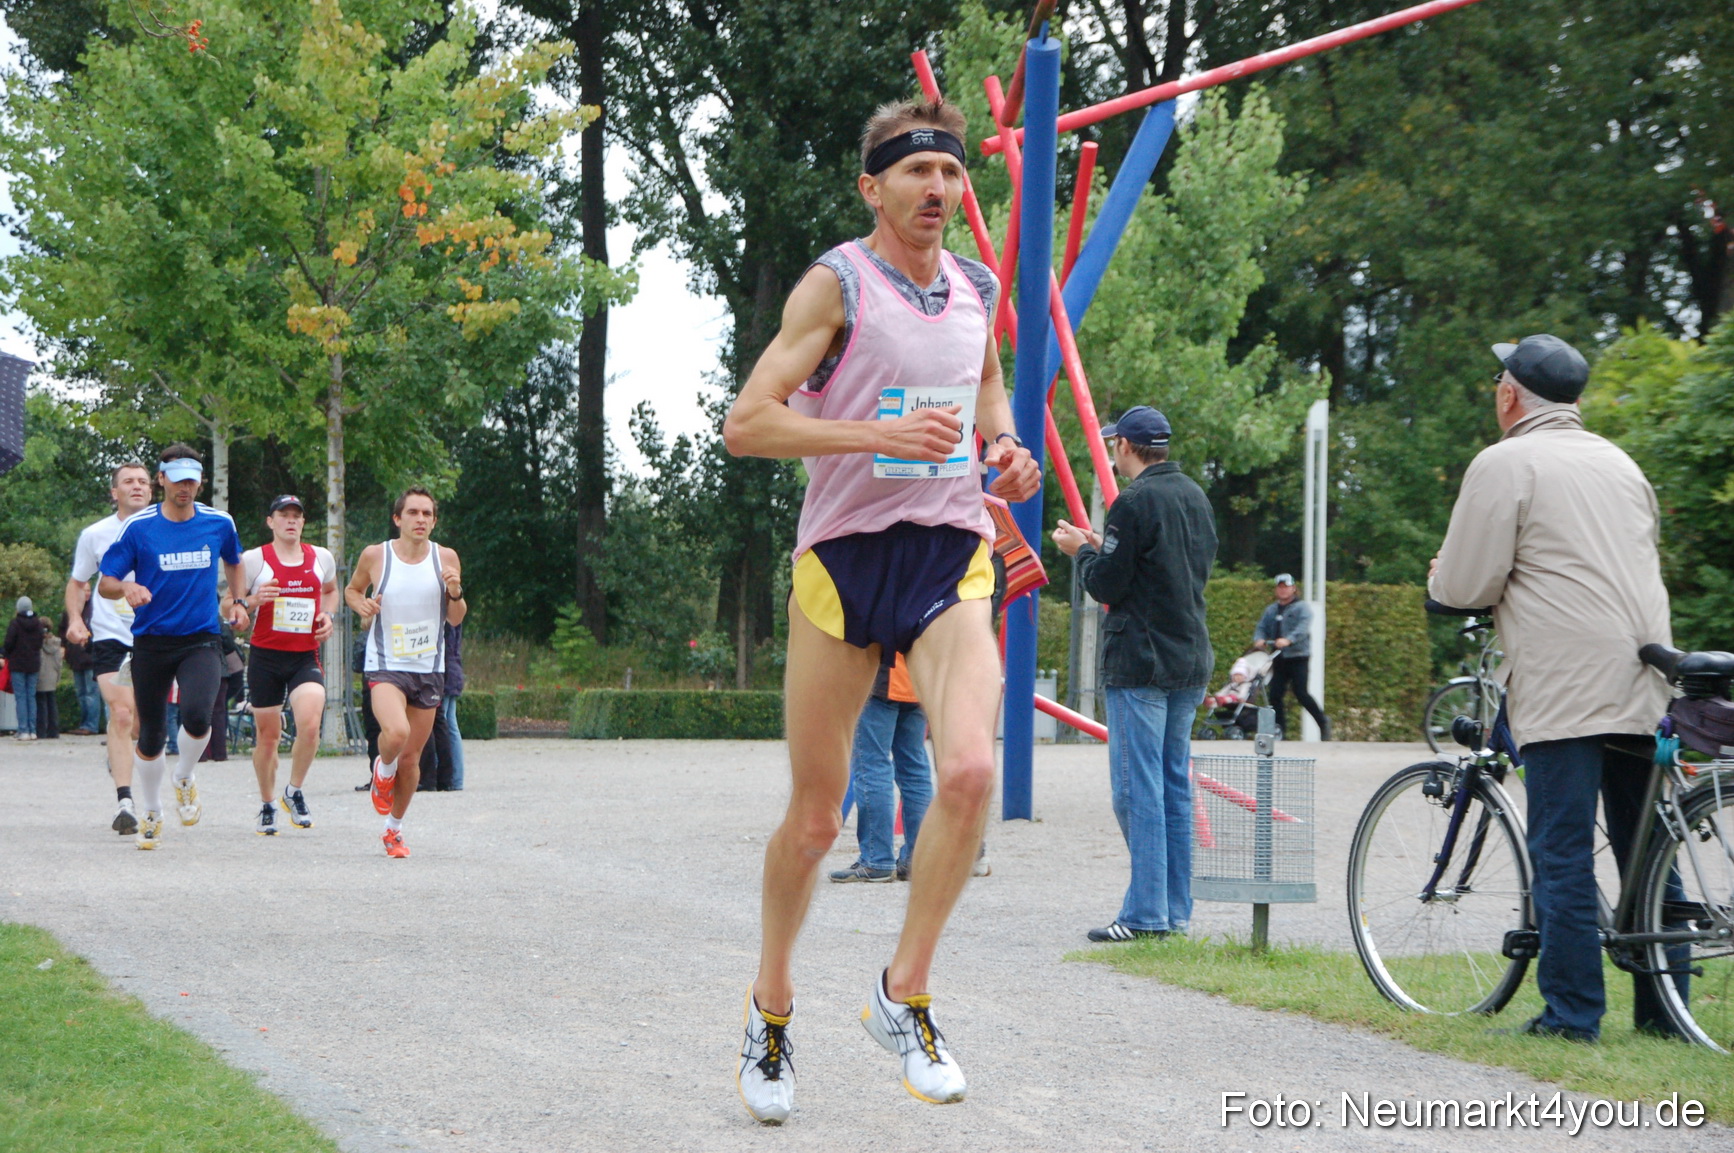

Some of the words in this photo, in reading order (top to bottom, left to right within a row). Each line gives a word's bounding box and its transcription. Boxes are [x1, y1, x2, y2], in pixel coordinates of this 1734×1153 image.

[940, 462, 968, 472] PFLEIDERER
[159, 551, 211, 565] HUBER
[289, 611, 309, 622] 222
[404, 625, 428, 635] Joachim
[410, 635, 429, 648] 744
